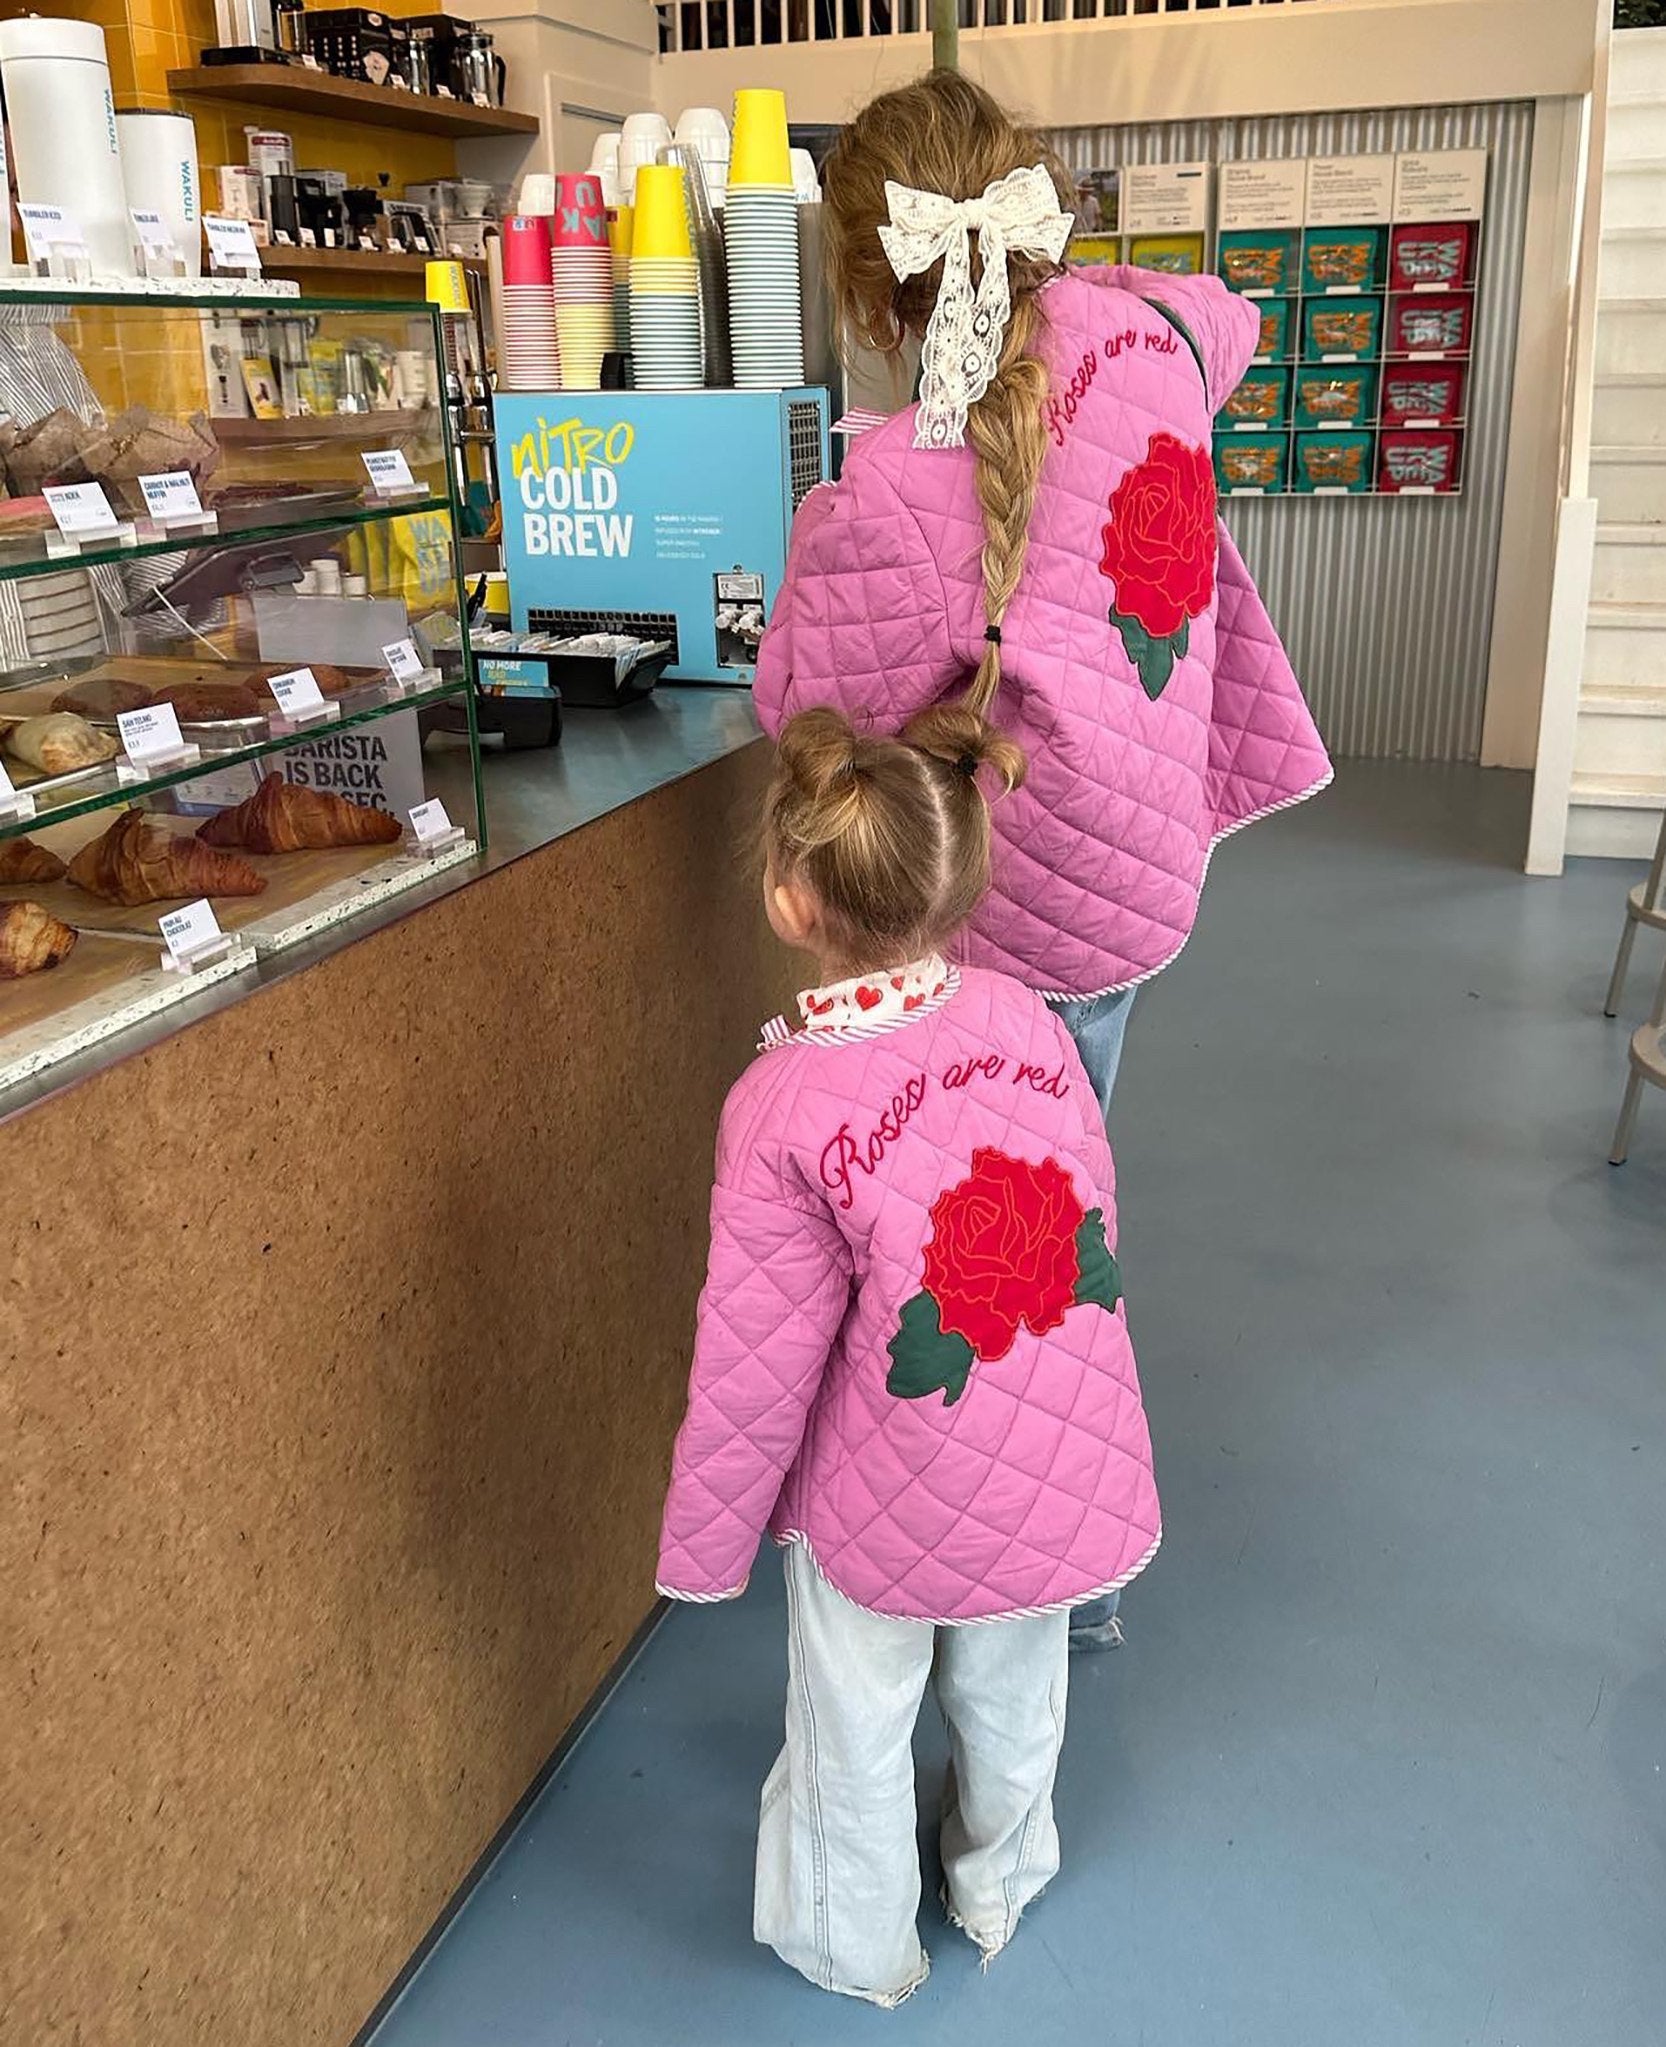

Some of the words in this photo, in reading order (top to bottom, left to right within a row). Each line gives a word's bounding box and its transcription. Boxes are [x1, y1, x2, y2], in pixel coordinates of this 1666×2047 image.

[104, 89, 118, 154] WAKULI
[180, 161, 194, 222] WAKULI
[1437, 239, 1461, 281] WA
[1441, 308, 1464, 347] WA
[1039, 350, 1098, 446] Roses
[1104, 329, 1137, 358] are
[1145, 325, 1178, 355] red
[1388, 382, 1407, 411] UP
[1427, 381, 1449, 415] WA
[1386, 447, 1407, 481] UP
[1426, 446, 1449, 484] WA
[520, 466, 618, 511] COLD
[523, 513, 634, 558] BREW
[482, 660, 496, 669] NO
[496, 660, 522, 671] MORE
[283, 735, 388, 761] ARISTA
[285, 761, 310, 785] IS
[314, 762, 384, 789] BACK
[820, 1073, 926, 1210] Roses
[942, 1054, 1006, 1090] are
[1012, 1062, 1070, 1099] red
